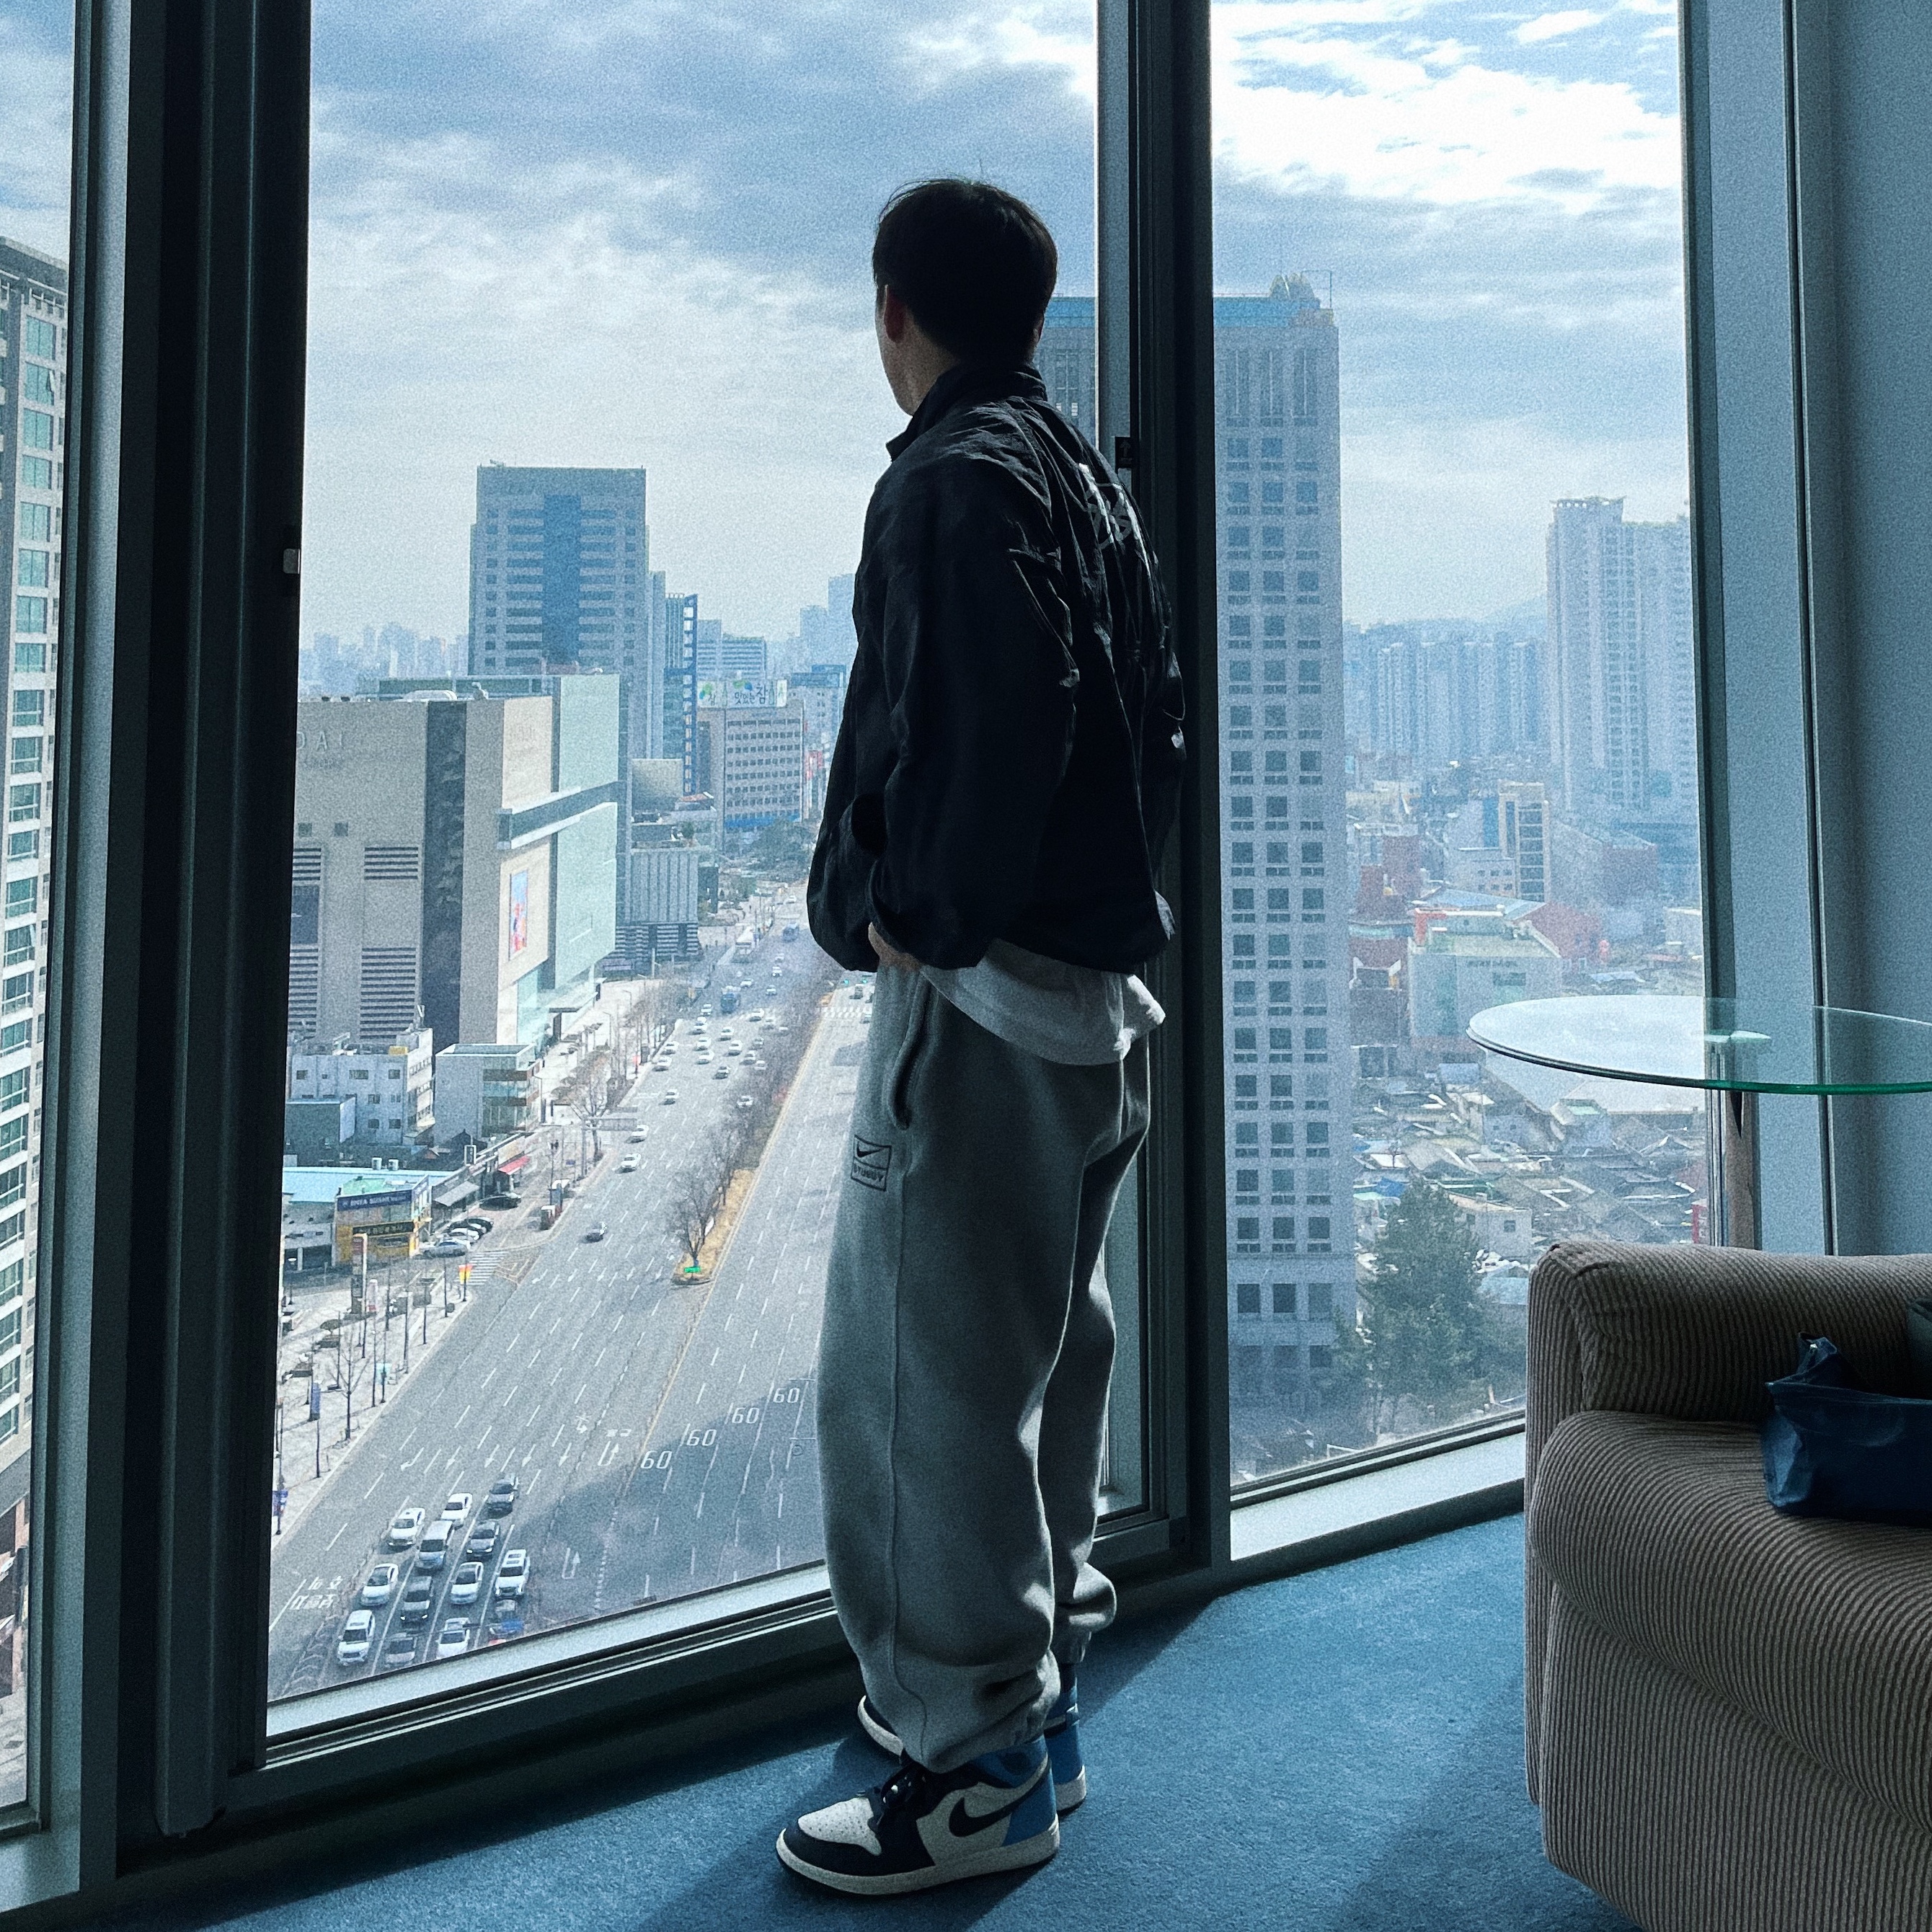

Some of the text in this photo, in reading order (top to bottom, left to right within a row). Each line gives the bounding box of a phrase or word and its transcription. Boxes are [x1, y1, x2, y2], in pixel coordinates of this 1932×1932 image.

[755, 683, 768, 705] 참
[773, 1387, 800, 1404] 60
[731, 1407, 760, 1424] 60
[686, 1429, 717, 1447] 60
[640, 1450, 673, 1469] 60
